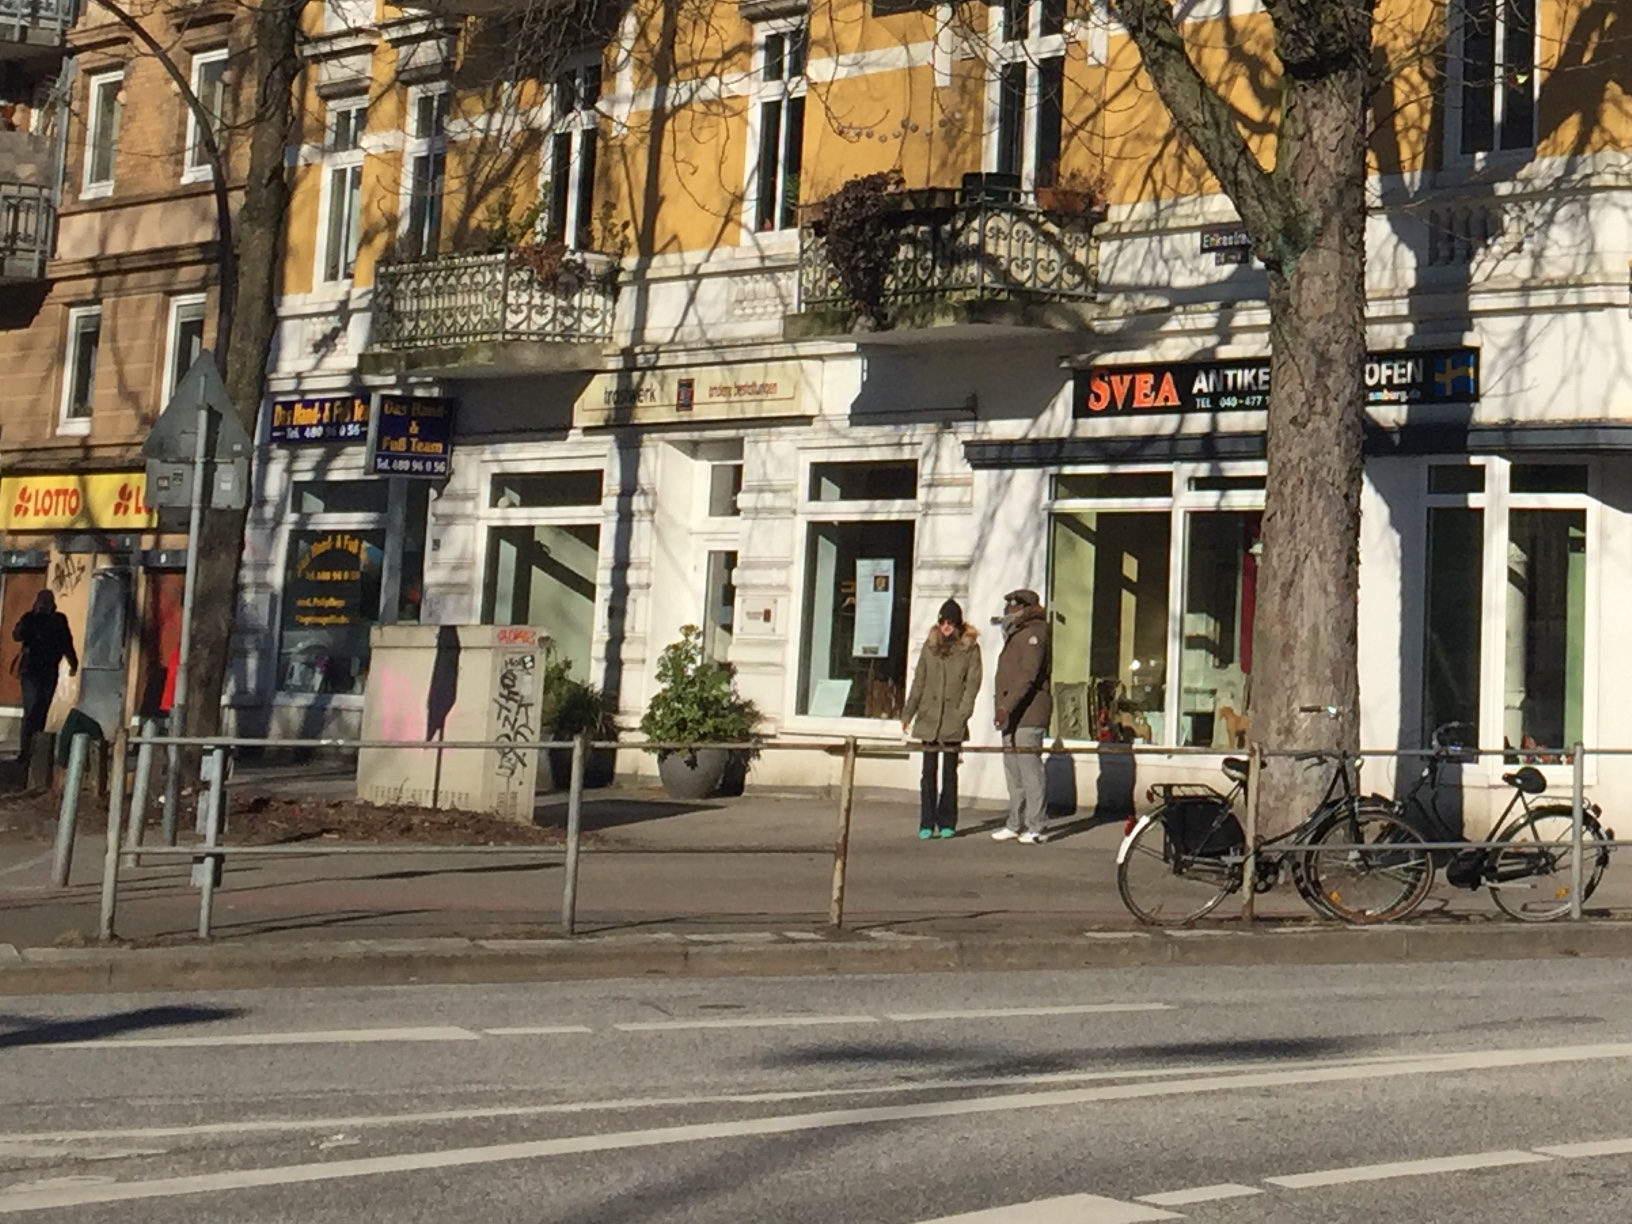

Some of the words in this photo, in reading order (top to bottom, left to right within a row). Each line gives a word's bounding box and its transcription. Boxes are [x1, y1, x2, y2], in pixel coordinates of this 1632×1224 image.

[1088, 369, 1181, 411] SVEA
[1192, 368, 1270, 394] ANTIKE
[1365, 356, 1423, 386] ÖFEN
[410, 438, 443, 454] Team
[33, 488, 80, 516] LOTTO
